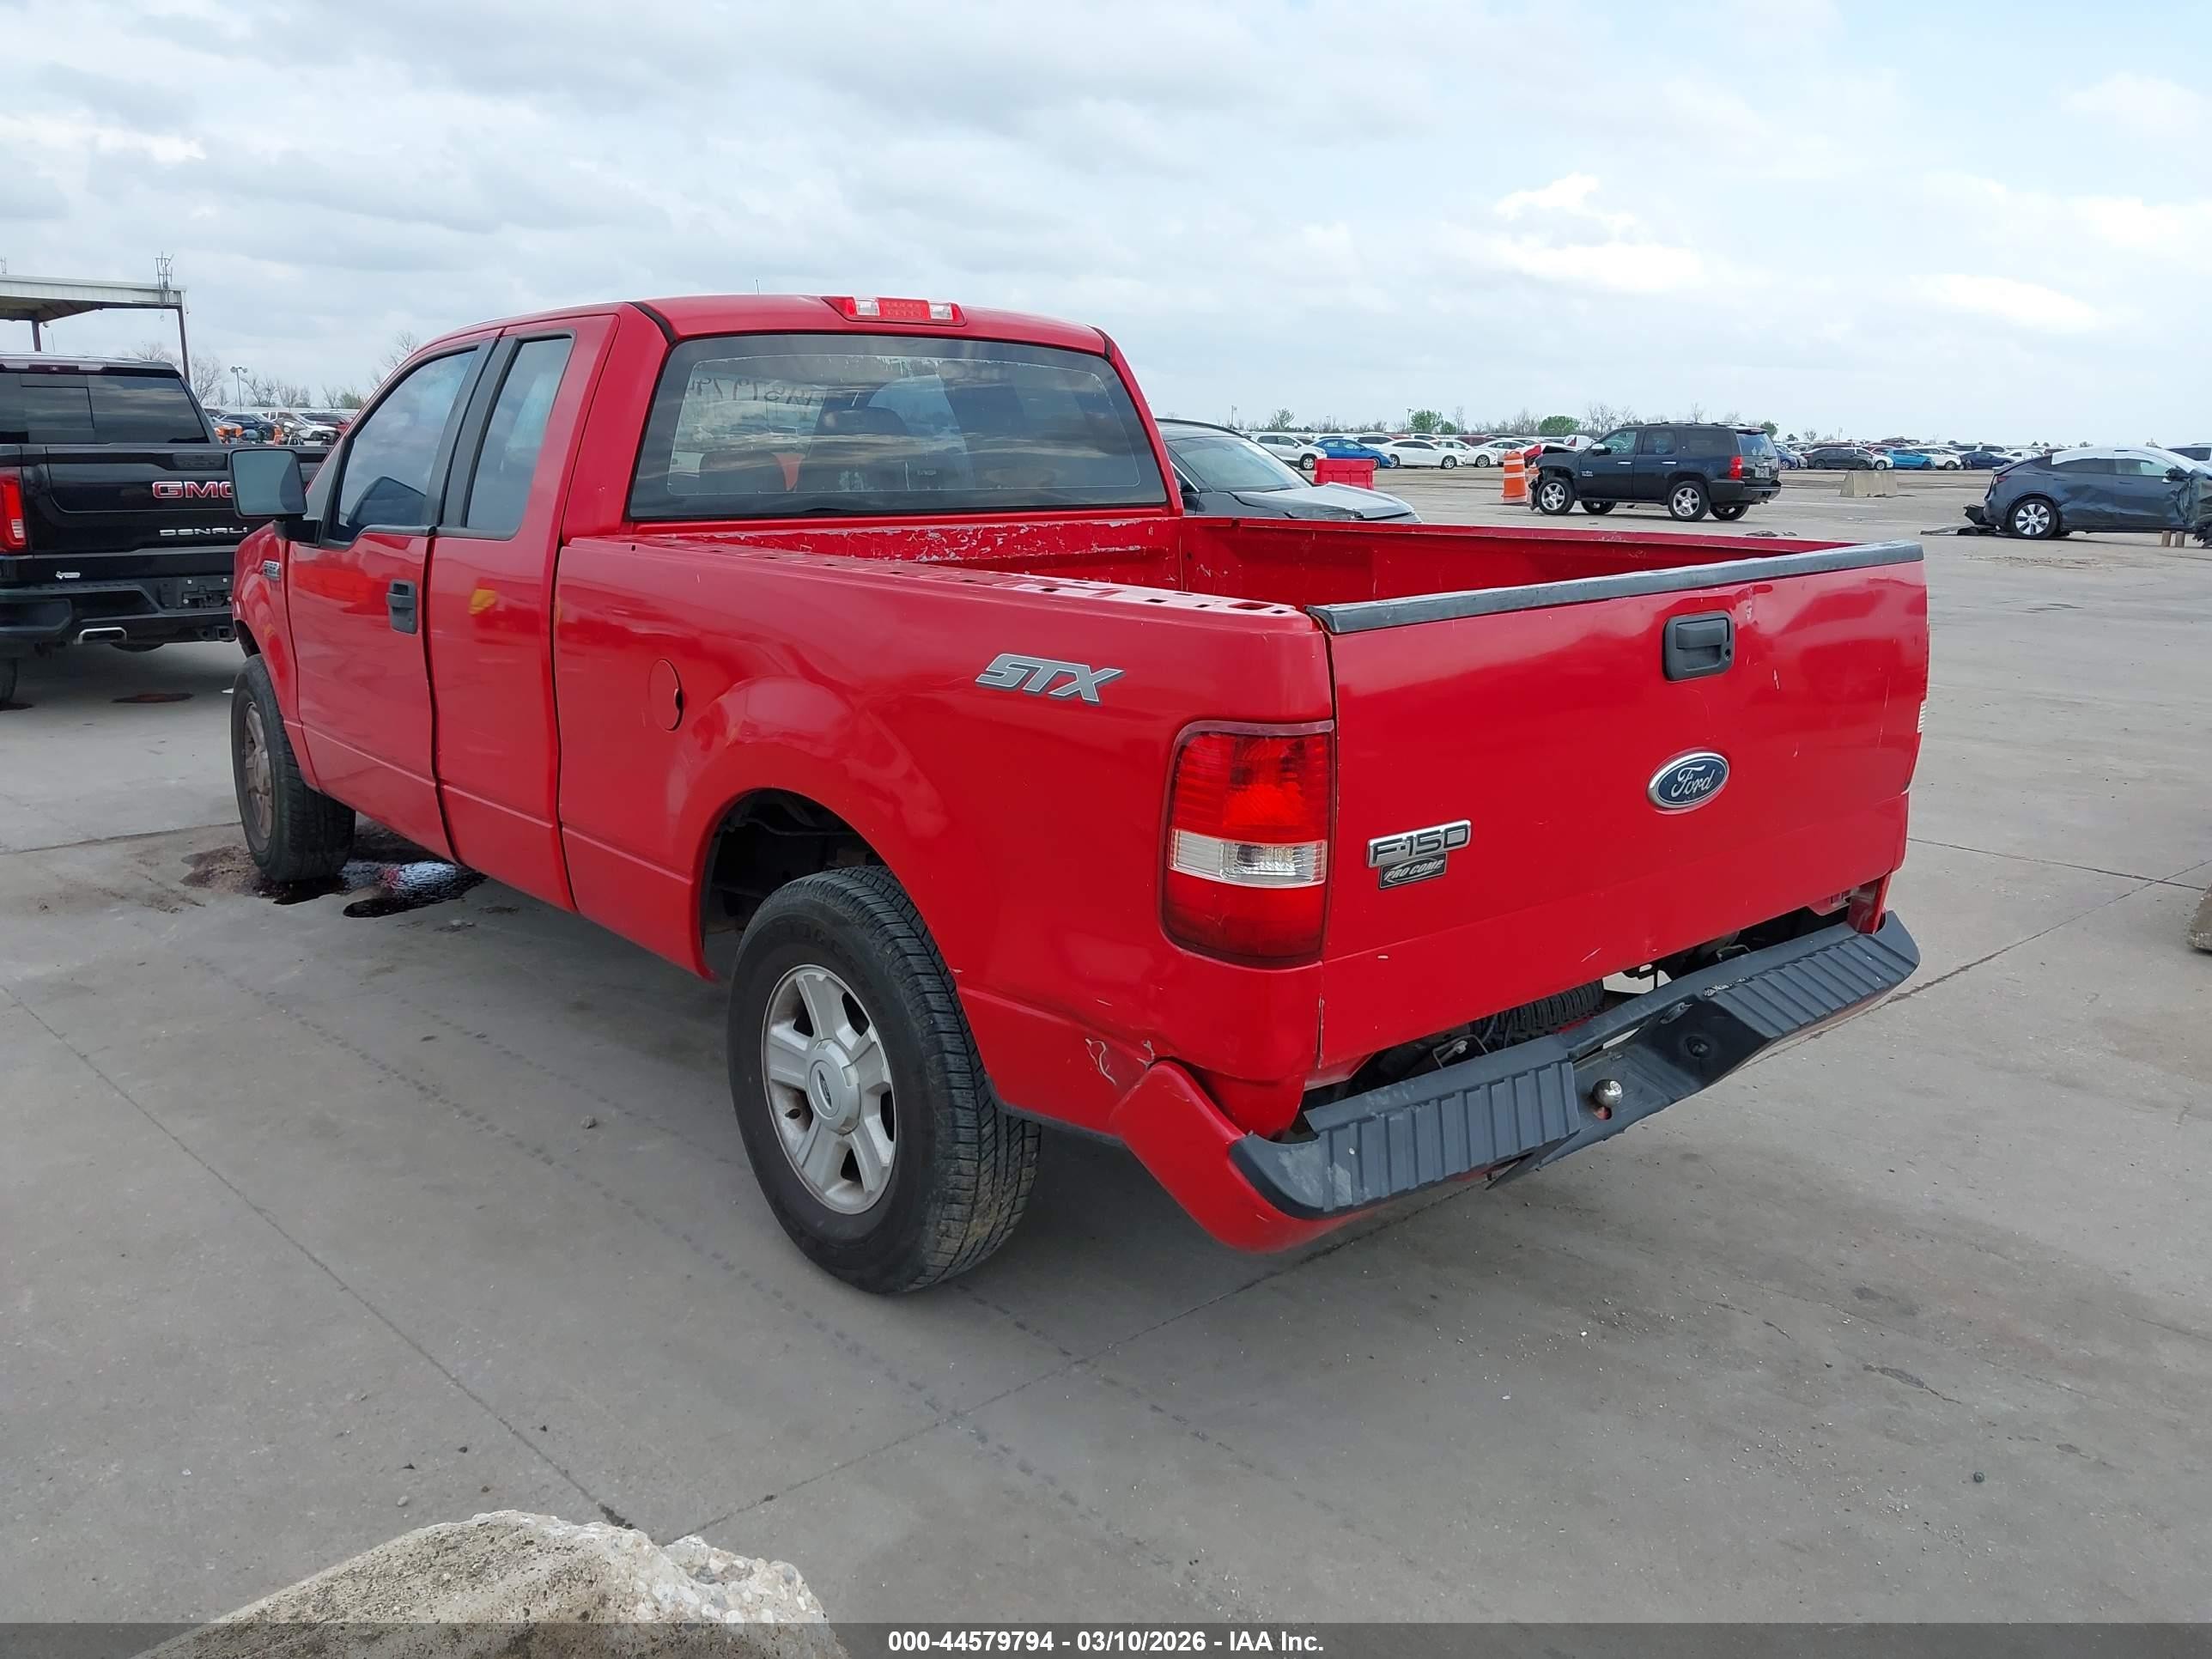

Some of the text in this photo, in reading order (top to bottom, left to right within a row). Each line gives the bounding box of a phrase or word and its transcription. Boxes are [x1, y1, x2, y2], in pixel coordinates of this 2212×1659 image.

[159, 526, 248, 537] DENALI
[975, 653, 1125, 705] STX
[1671, 764, 1716, 798] Ford
[1372, 823, 1468, 865] F-150
[1383, 859, 1445, 881] PRO COMP
